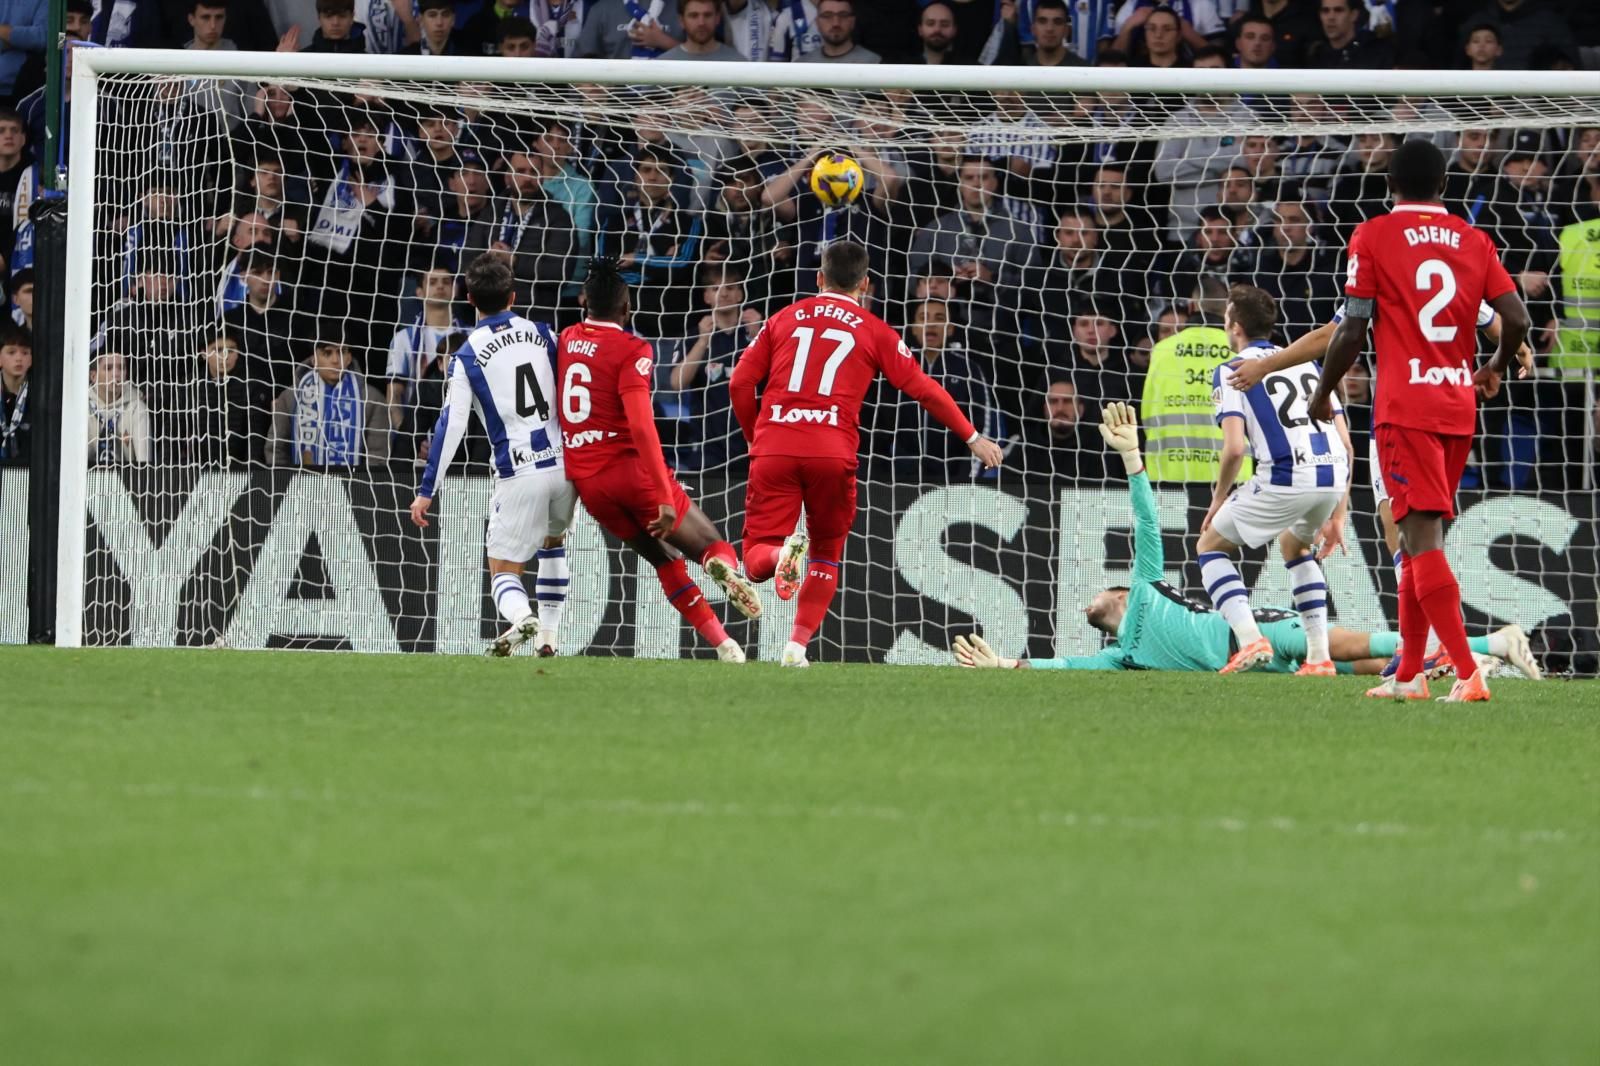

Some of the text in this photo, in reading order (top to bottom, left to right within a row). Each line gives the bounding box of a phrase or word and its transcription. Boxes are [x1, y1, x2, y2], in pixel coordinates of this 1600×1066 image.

[1403, 225, 1461, 249] DJENE
[1415, 258, 1458, 342] 2
[795, 303, 863, 328] C. PÉREZ
[476, 330, 548, 368] ZUBIMENDI
[567, 339, 598, 357] UCHE
[787, 326, 856, 397] 17
[1175, 343, 1230, 360] SABICO
[1408, 358, 1473, 387] Lowi
[516, 362, 550, 421] 4
[562, 362, 592, 424] 6
[769, 404, 838, 426] Lowi
[512, 446, 562, 466] kutxaba
